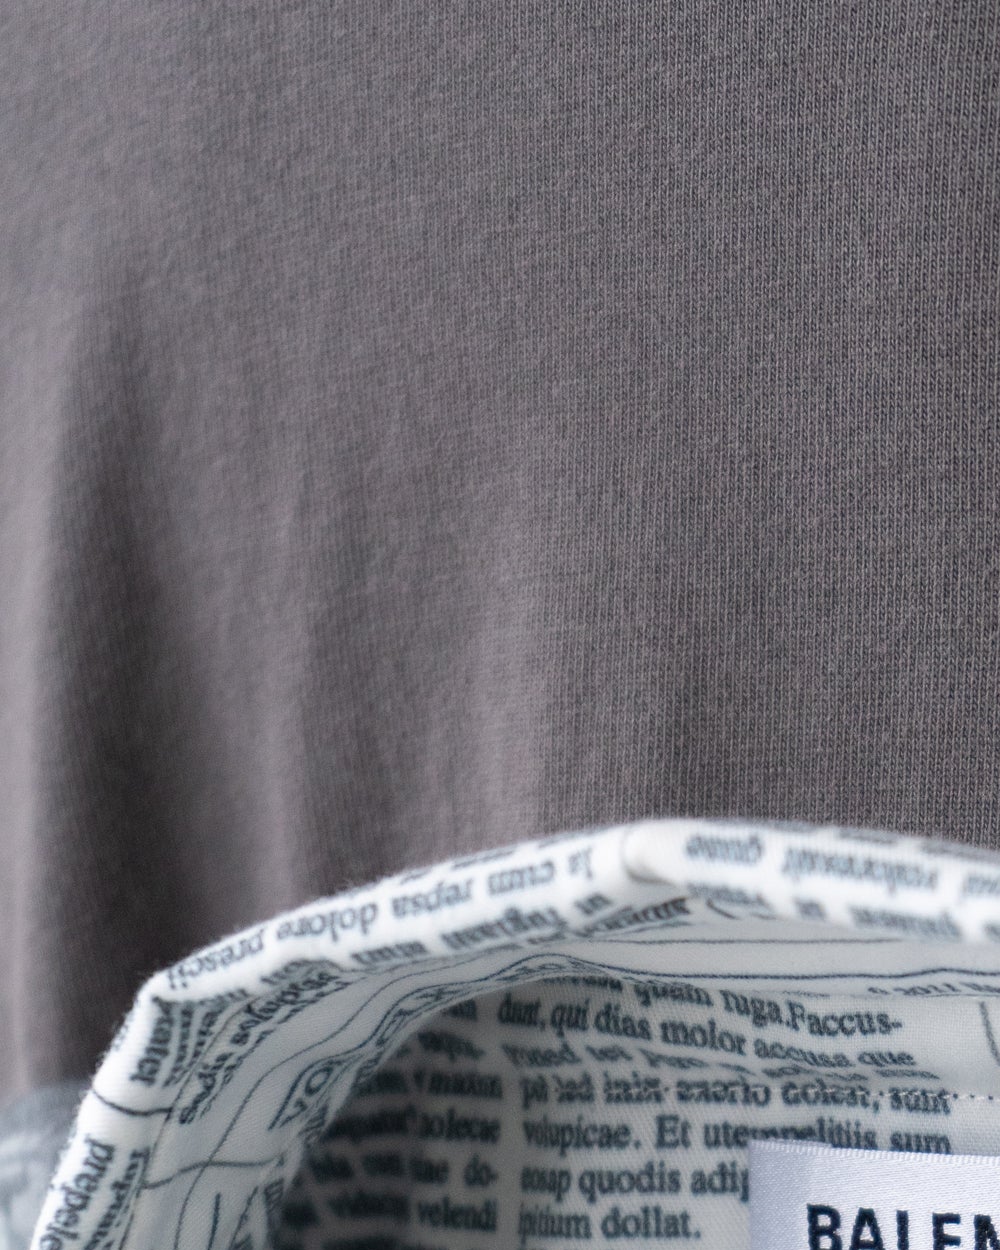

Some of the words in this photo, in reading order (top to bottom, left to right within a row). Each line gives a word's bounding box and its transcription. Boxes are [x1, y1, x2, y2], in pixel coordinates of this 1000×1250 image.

[593, 1002, 652, 1041] dias
[660, 1017, 747, 1056] molor
[655, 1114, 693, 1149] Et
[578, 1159, 680, 1204] quodis
[601, 1205, 701, 1240] dollat.
